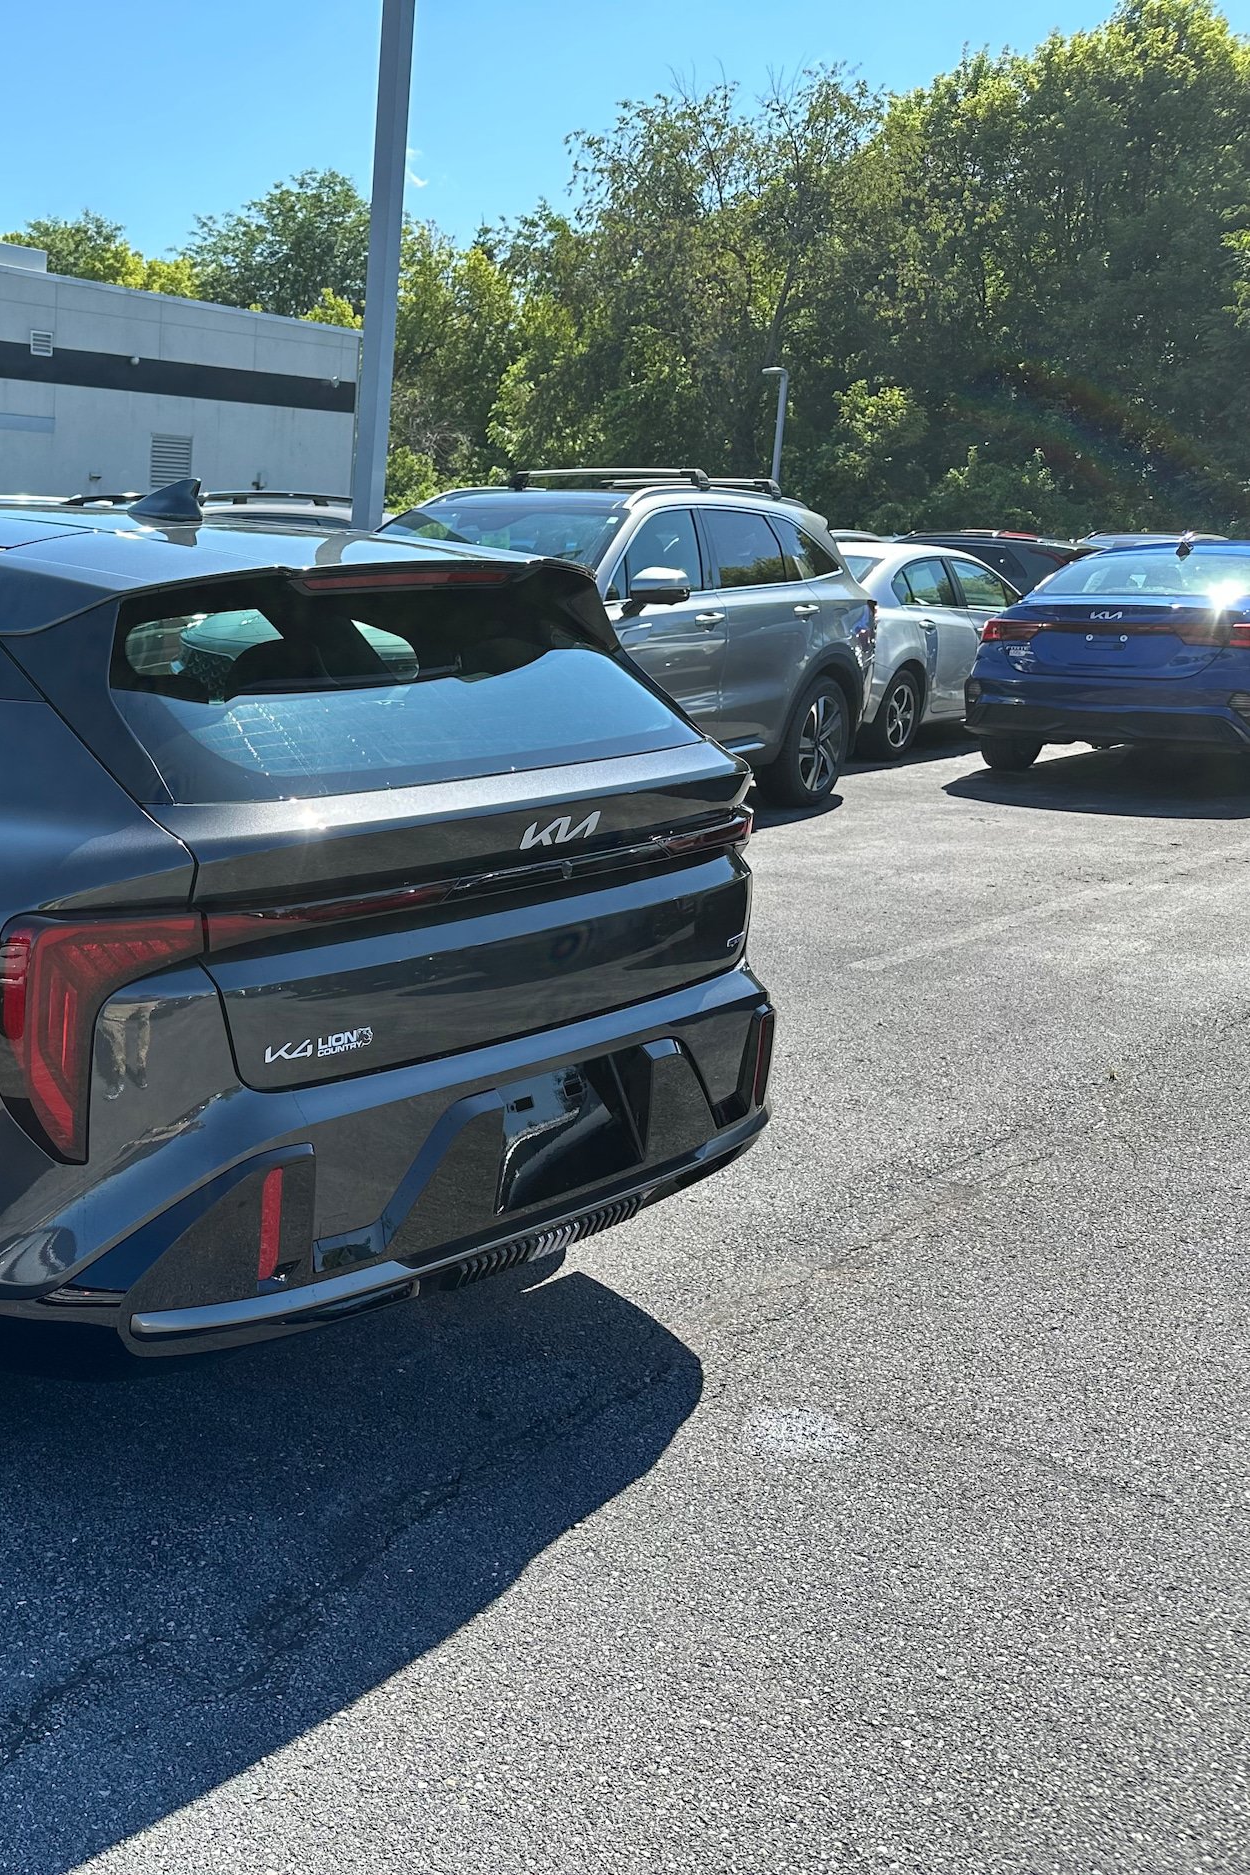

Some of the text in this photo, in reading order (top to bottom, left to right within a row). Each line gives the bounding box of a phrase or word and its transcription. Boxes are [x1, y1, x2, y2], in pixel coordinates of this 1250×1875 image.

[1090, 611, 1122, 619] KIA
[519, 810, 601, 850] KIA
[317, 1030, 357, 1050] LION
[317, 1040, 363, 1057] COUNTRY
[264, 1039, 313, 1063] K4
